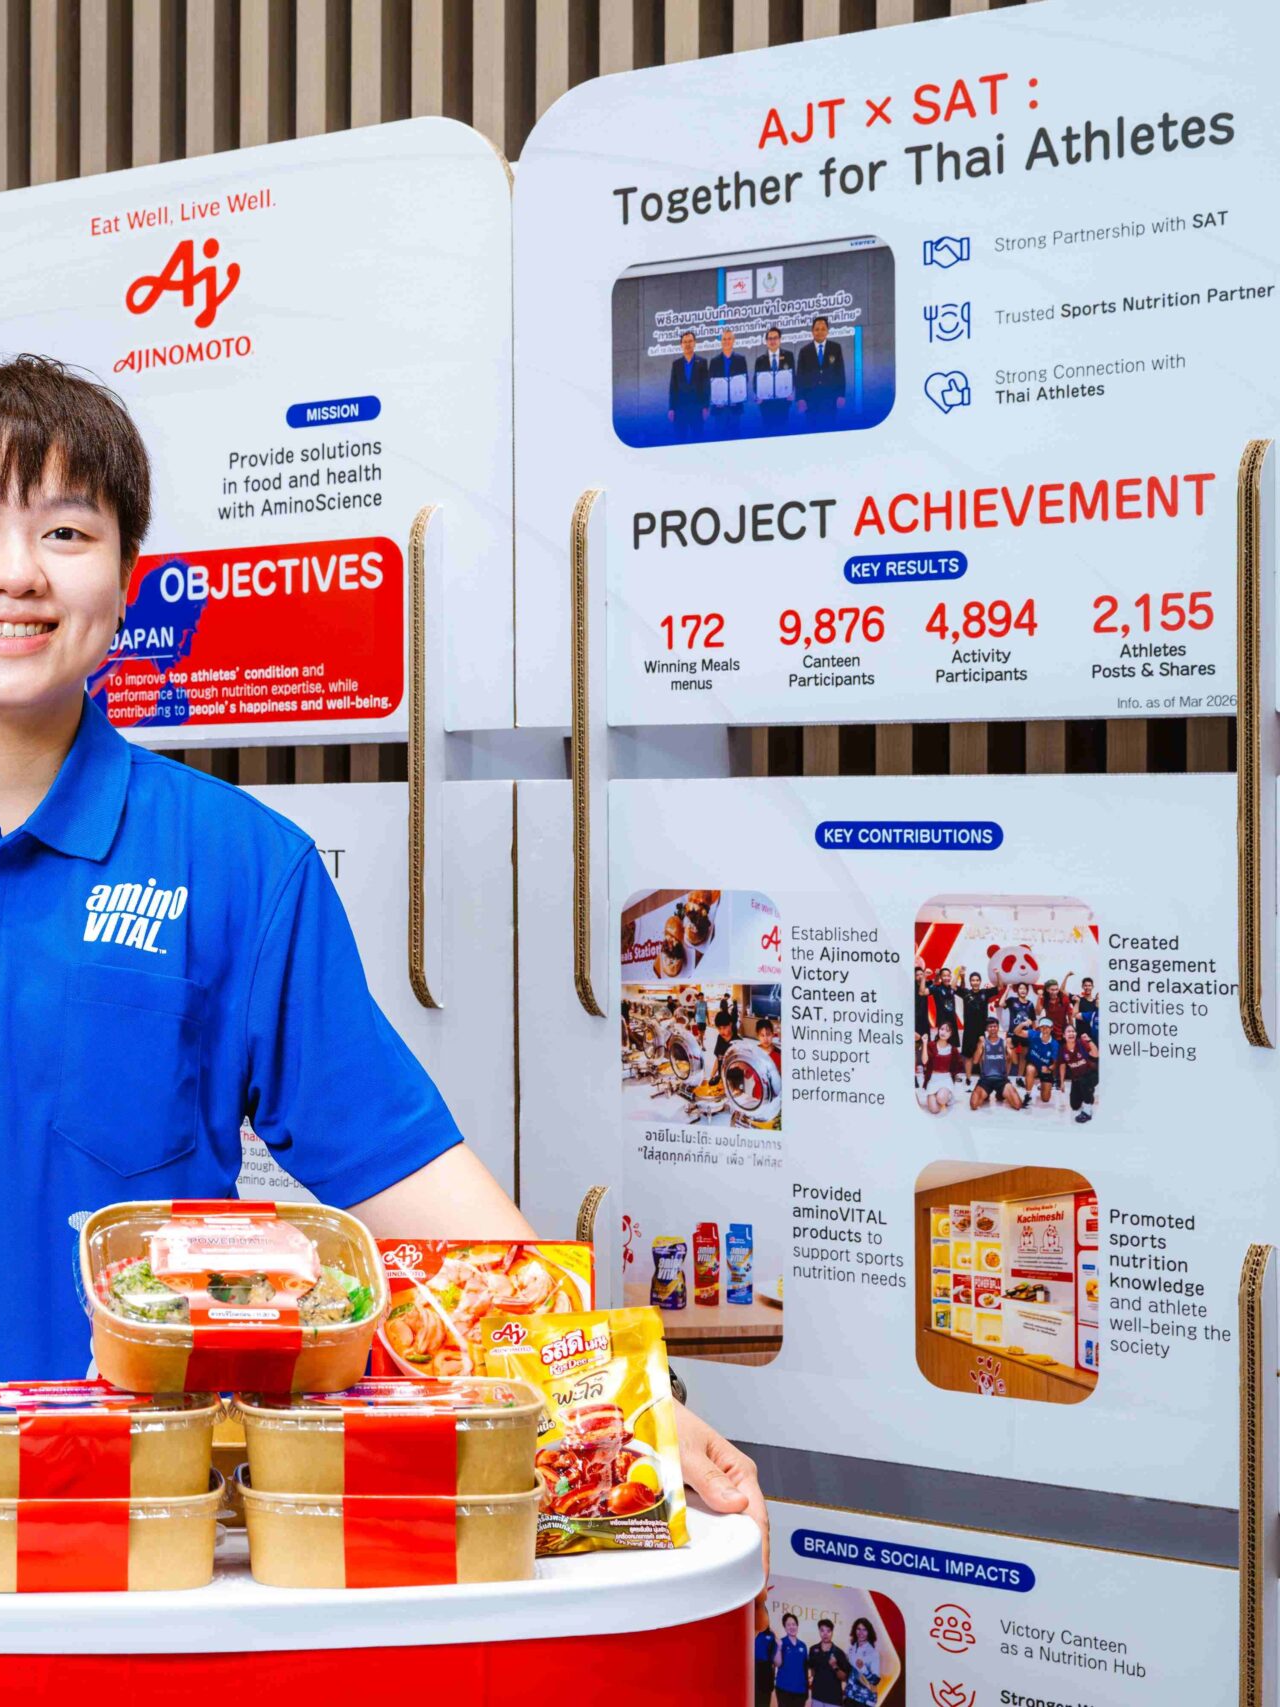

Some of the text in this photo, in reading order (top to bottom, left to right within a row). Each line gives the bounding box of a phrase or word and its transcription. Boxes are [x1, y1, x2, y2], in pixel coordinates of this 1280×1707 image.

[758, 97, 845, 149] AJT
[913, 72, 1008, 126] SAT
[613, 110, 1236, 225] Together for Thai Athletes
[90, 189, 276, 236] Eat Well, Live Well.
[994, 211, 1229, 253] Strong Partnership with SAT
[994, 284, 1275, 326] Trusted Sports Nutrition Partner
[113, 335, 252, 373] AJINOMOTO
[995, 354, 1186, 385] Strong Connection with
[995, 383, 1106, 405] Thai Athletes
[306, 403, 359, 422] MISSION
[229, 440, 382, 469] Provide solutions
[223, 463, 381, 494] in food and health
[218, 491, 382, 520] with AminoScience
[633, 473, 1217, 550] PROJECT ACHIEVEMENT
[160, 552, 384, 603] OBJECTIVES
[850, 556, 960, 579] KEY RESULTS
[925, 598, 1038, 644] 4,894
[1092, 591, 1214, 638] 2,155
[109, 626, 174, 651] JAPAN
[660, 613, 724, 650] 172
[779, 605, 885, 650] 9,876
[803, 654, 860, 668] Canteen
[951, 649, 1011, 664] Activity
[1120, 643, 1186, 658] Athletes
[644, 658, 740, 674] Winning Meals
[935, 667, 1028, 683] Participants
[1091, 661, 1216, 678] Posts & Shares
[671, 678, 713, 691] menus
[789, 672, 875, 687] Participants
[1117, 694, 1237, 709] Info. as of Mar 2026
[823, 828, 993, 844] KEY CONTRIBUTIONS
[86, 877, 188, 920] amino
[1108, 933, 1179, 950] Created
[1108, 957, 1216, 973] engagement
[1108, 977, 1140, 992] and
[1108, 998, 1208, 1016] activities to
[1108, 1021, 1178, 1036] promote
[1108, 1041, 1197, 1061] well-being
[792, 1183, 861, 1202] Provided
[792, 1205, 888, 1225] aminoVITAL
[1017, 1210, 1064, 1224] Kachimeshi
[792, 1226, 882, 1245] products to
[793, 1246, 904, 1267] support sports
[793, 1265, 907, 1288] nutrition needs
[803, 1537, 1020, 1585] BRAND & SOCIAL IMPACTS
[1000, 1619, 1127, 1654] Victory Canteen
[1000, 1642, 1146, 1678] as a Nutrition Hub
